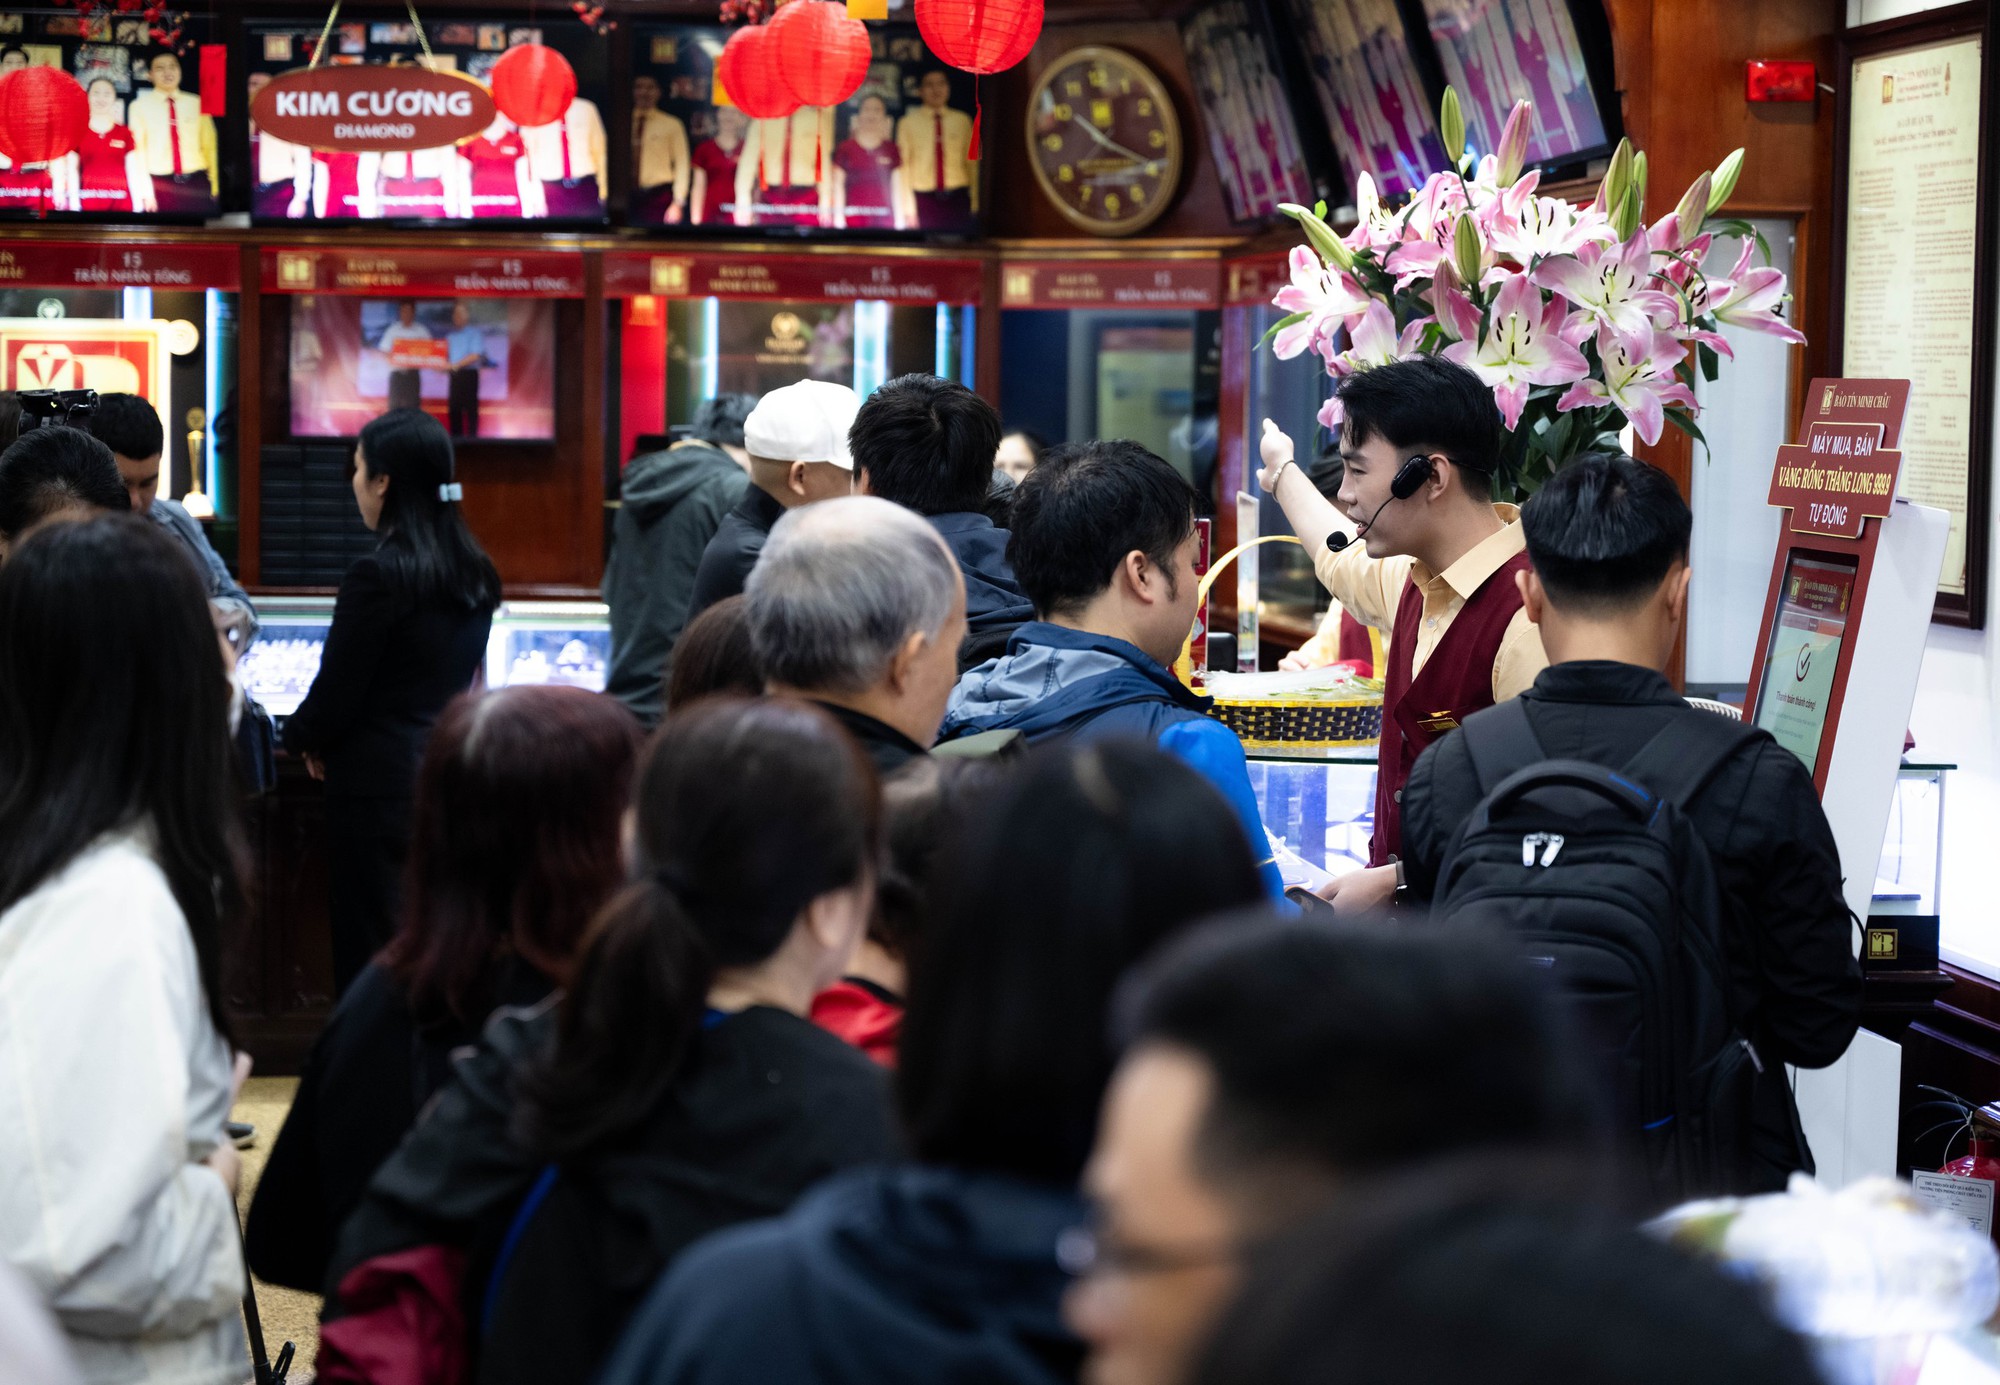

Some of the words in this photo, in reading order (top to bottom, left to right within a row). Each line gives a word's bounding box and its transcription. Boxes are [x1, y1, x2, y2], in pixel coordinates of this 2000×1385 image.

[275, 91, 340, 117] KIM
[346, 88, 472, 117] CƯƠNG
[334, 123, 415, 139] DIAMOND
[1834, 391, 1847, 407] BẢO
[1847, 392, 1858, 408] TÍN
[1857, 395, 1874, 408] MINH
[1873, 392, 1891, 409] CHÂU
[1811, 431, 1832, 454] MÁY
[1833, 436, 1853, 459] MUA,
[1854, 433, 1874, 456] BÁN
[1779, 461, 1802, 488] VÀNG
[1801, 460, 1825, 491] RỒNG
[1825, 465, 1852, 493] THĂNG
[1851, 472, 1874, 494] LONG
[1809, 503, 1822, 527] TỰ
[1822, 503, 1848, 528] ĐỘNG
